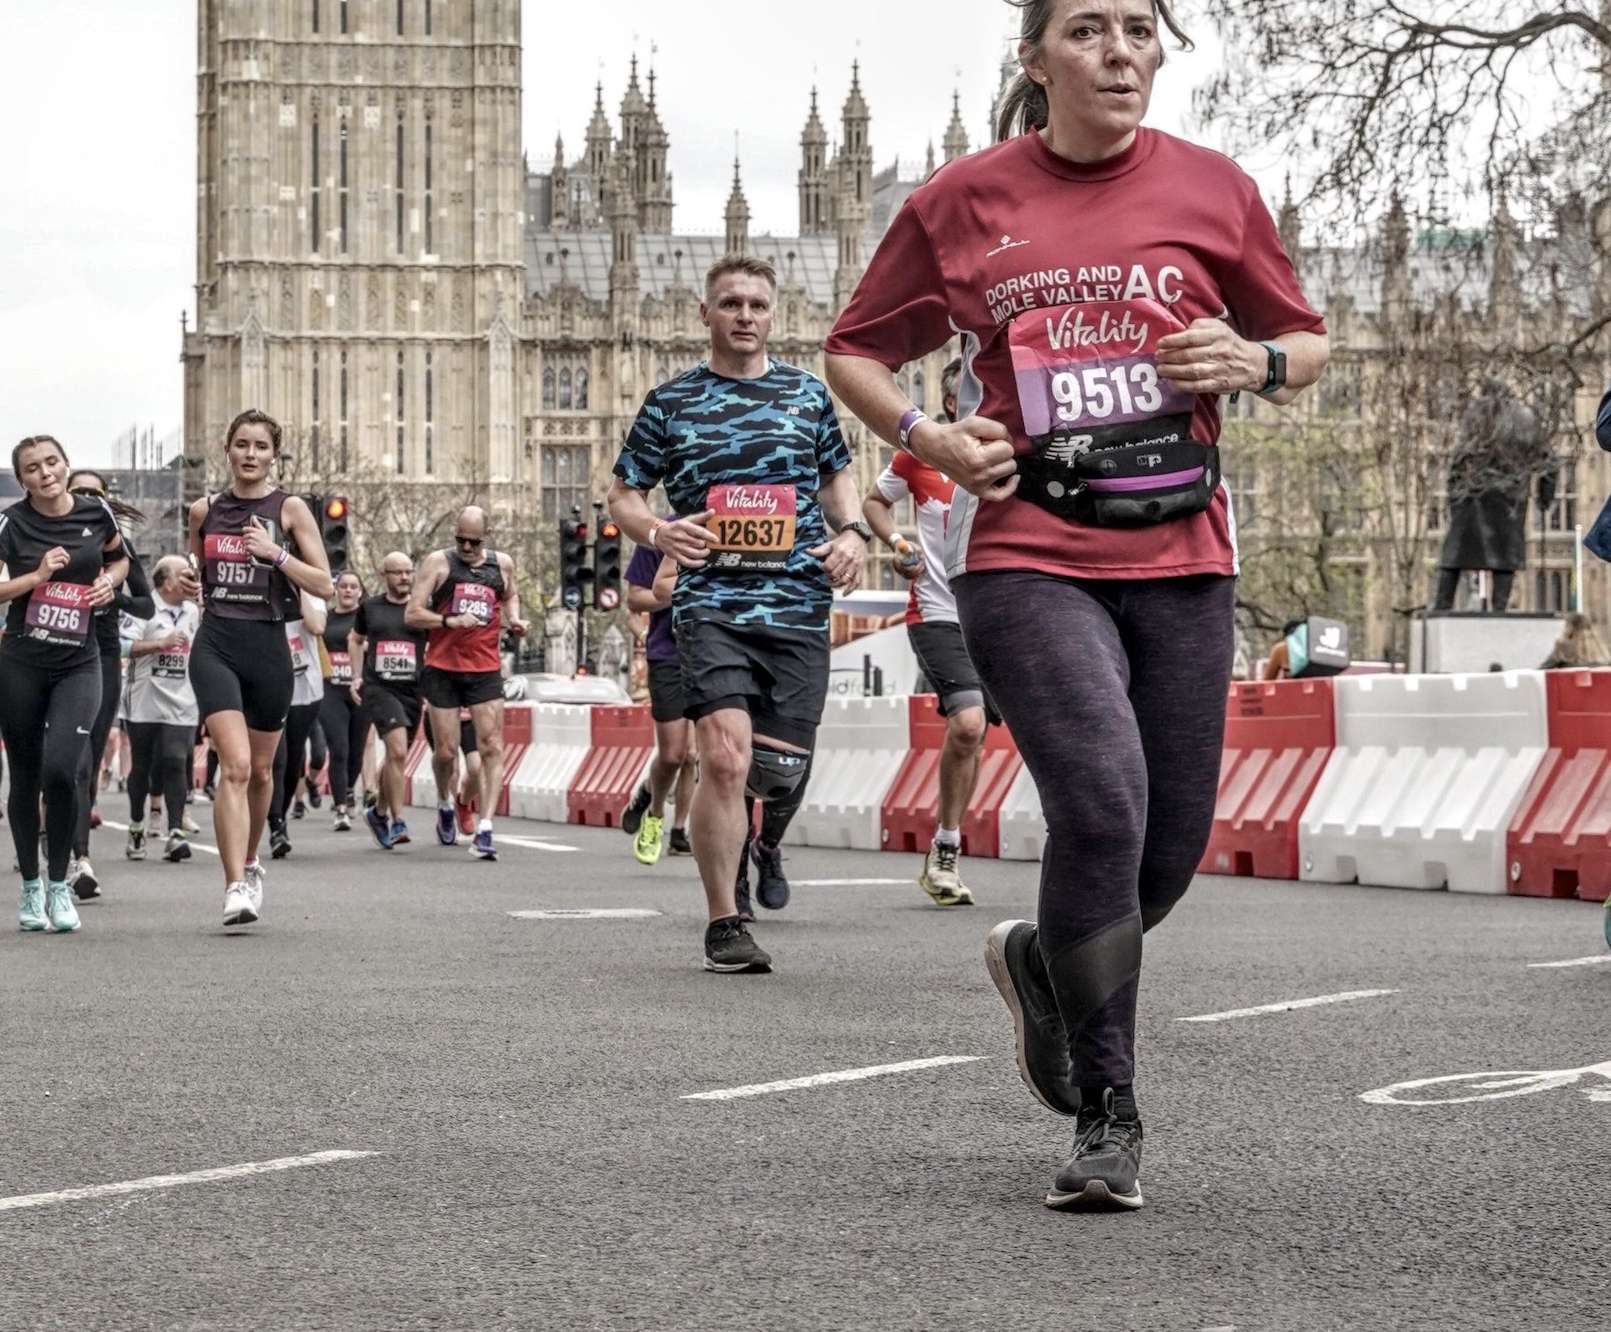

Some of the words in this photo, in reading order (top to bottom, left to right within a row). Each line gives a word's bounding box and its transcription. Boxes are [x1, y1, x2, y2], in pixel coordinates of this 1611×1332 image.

[985, 268, 1071, 306] DORKING
[1076, 265, 1122, 283] AND
[1122, 264, 1184, 304] AC
[991, 292, 1036, 324] MOLE
[1042, 284, 1125, 305] VALLEY
[1046, 306, 1149, 354] Vitality
[1051, 362, 1163, 422] 9513
[726, 486, 778, 515] Vitality
[217, 535, 247, 554] Vitali
[718, 519, 785, 546] 12637
[217, 561, 255, 584] 9757
[45, 582, 82, 606] Vitality
[459, 598, 488, 617] 9285
[37, 603, 81, 630] 9756
[158, 654, 185, 667] 8299
[383, 657, 409, 669] 8541
